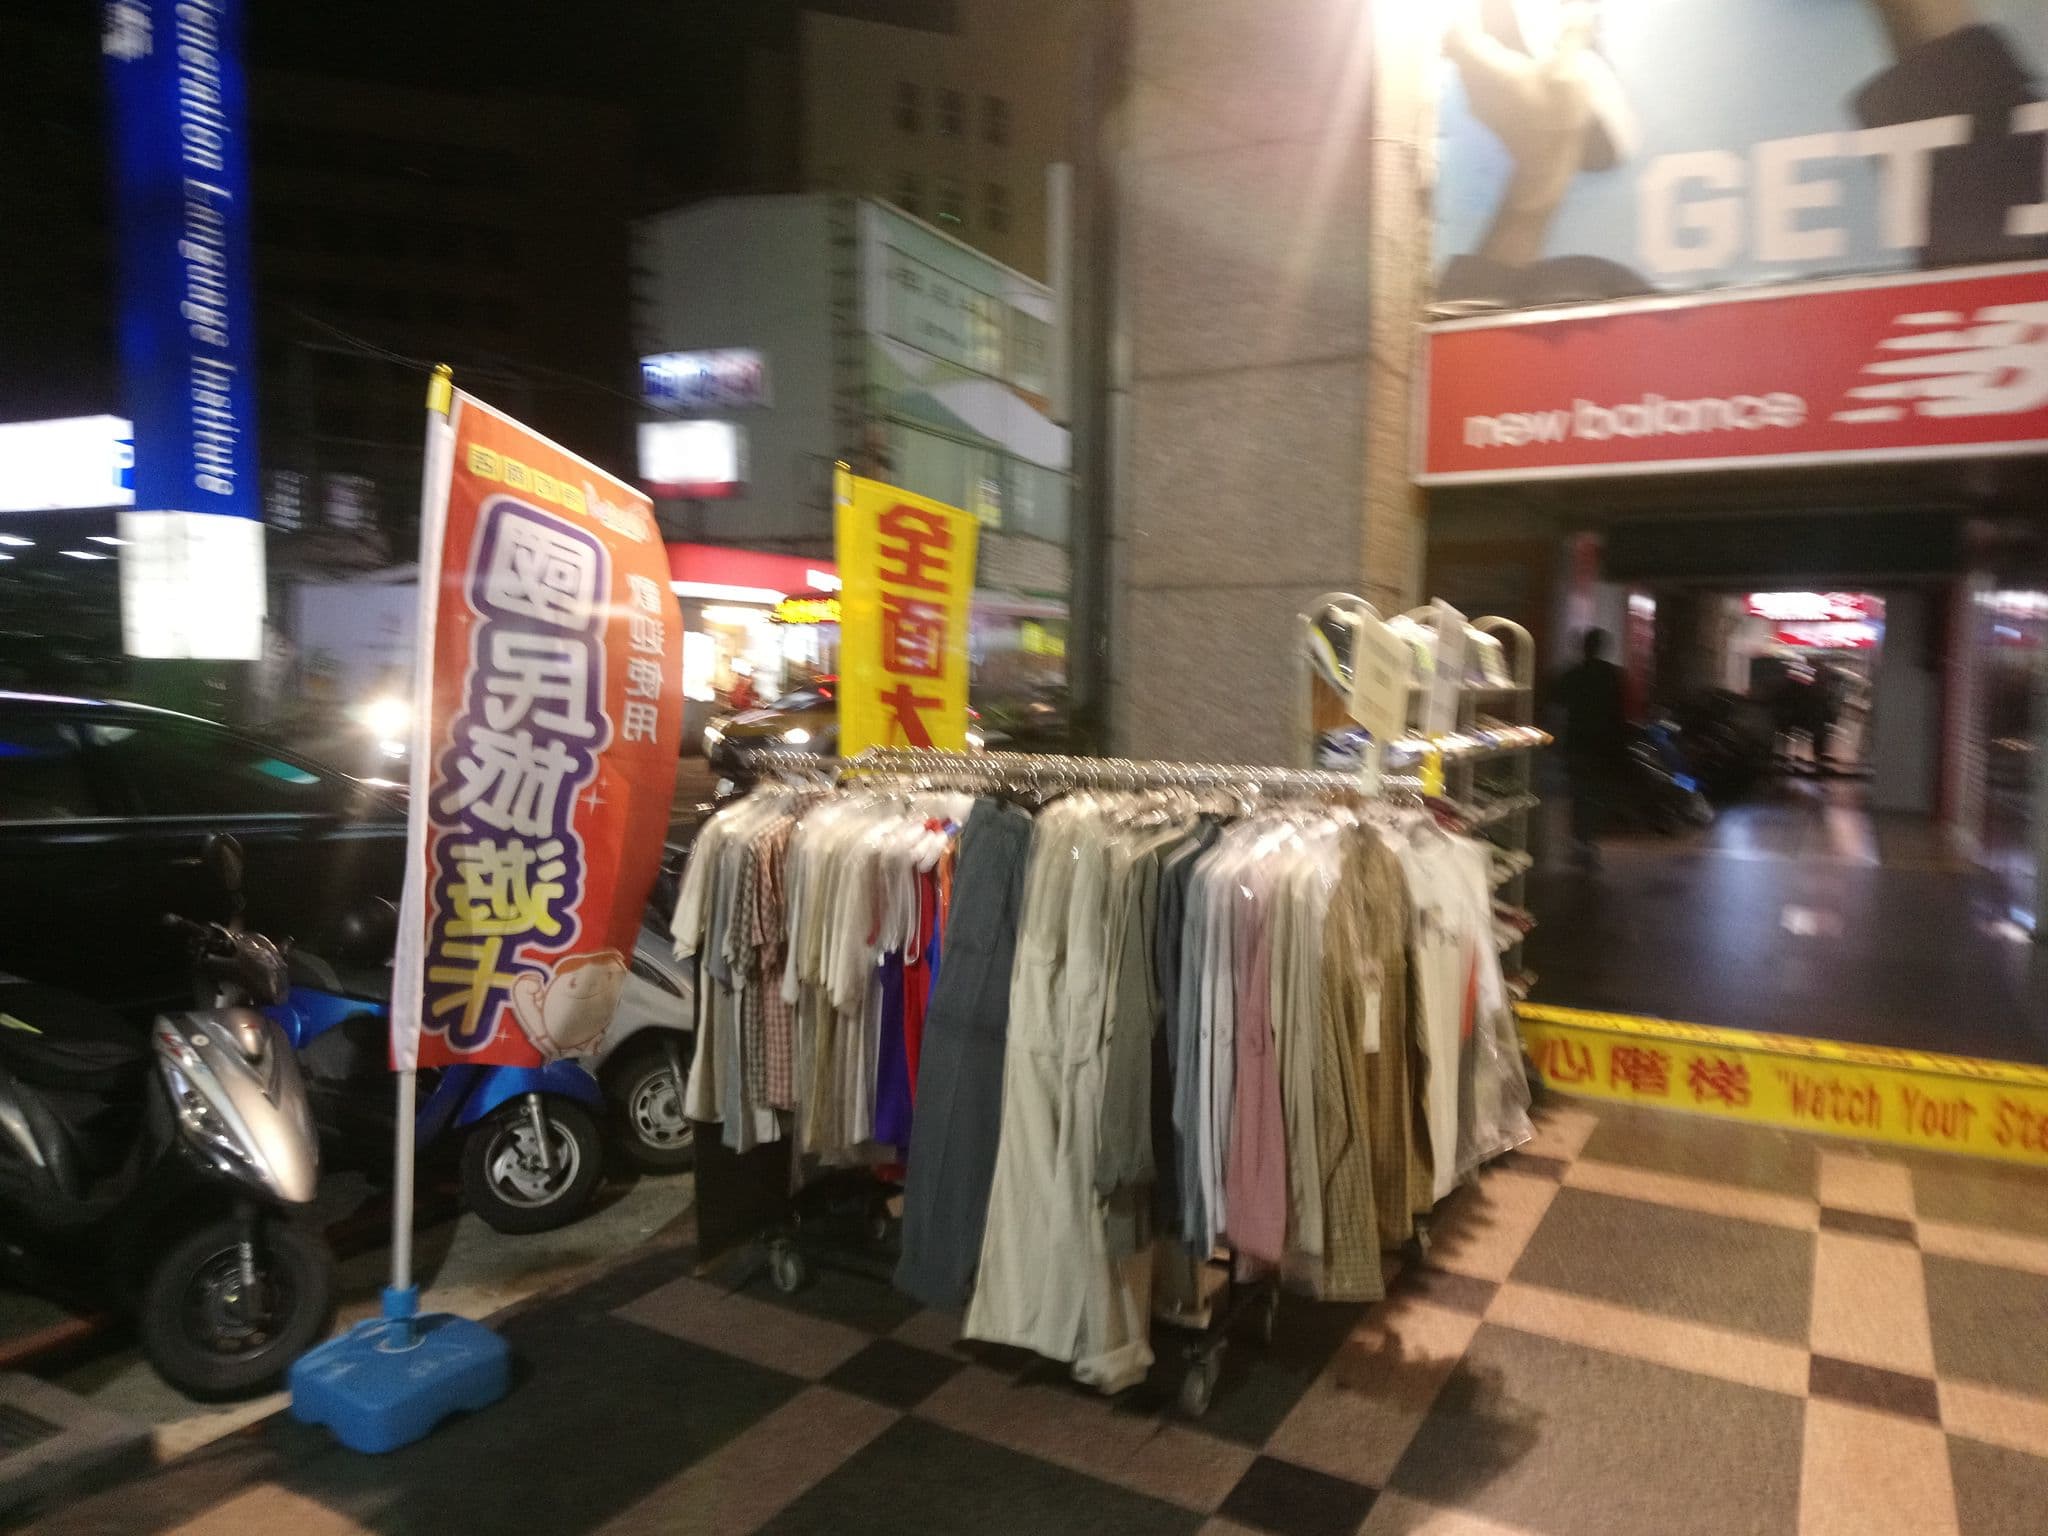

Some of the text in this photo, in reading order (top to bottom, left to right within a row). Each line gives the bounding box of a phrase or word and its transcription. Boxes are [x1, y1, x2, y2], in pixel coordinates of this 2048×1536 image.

[176, 0, 231, 170] eneration
[178, 177, 233, 347] Language
[1636, 114, 1975, 274] GET
[1464, 392, 1806, 448] new balance
